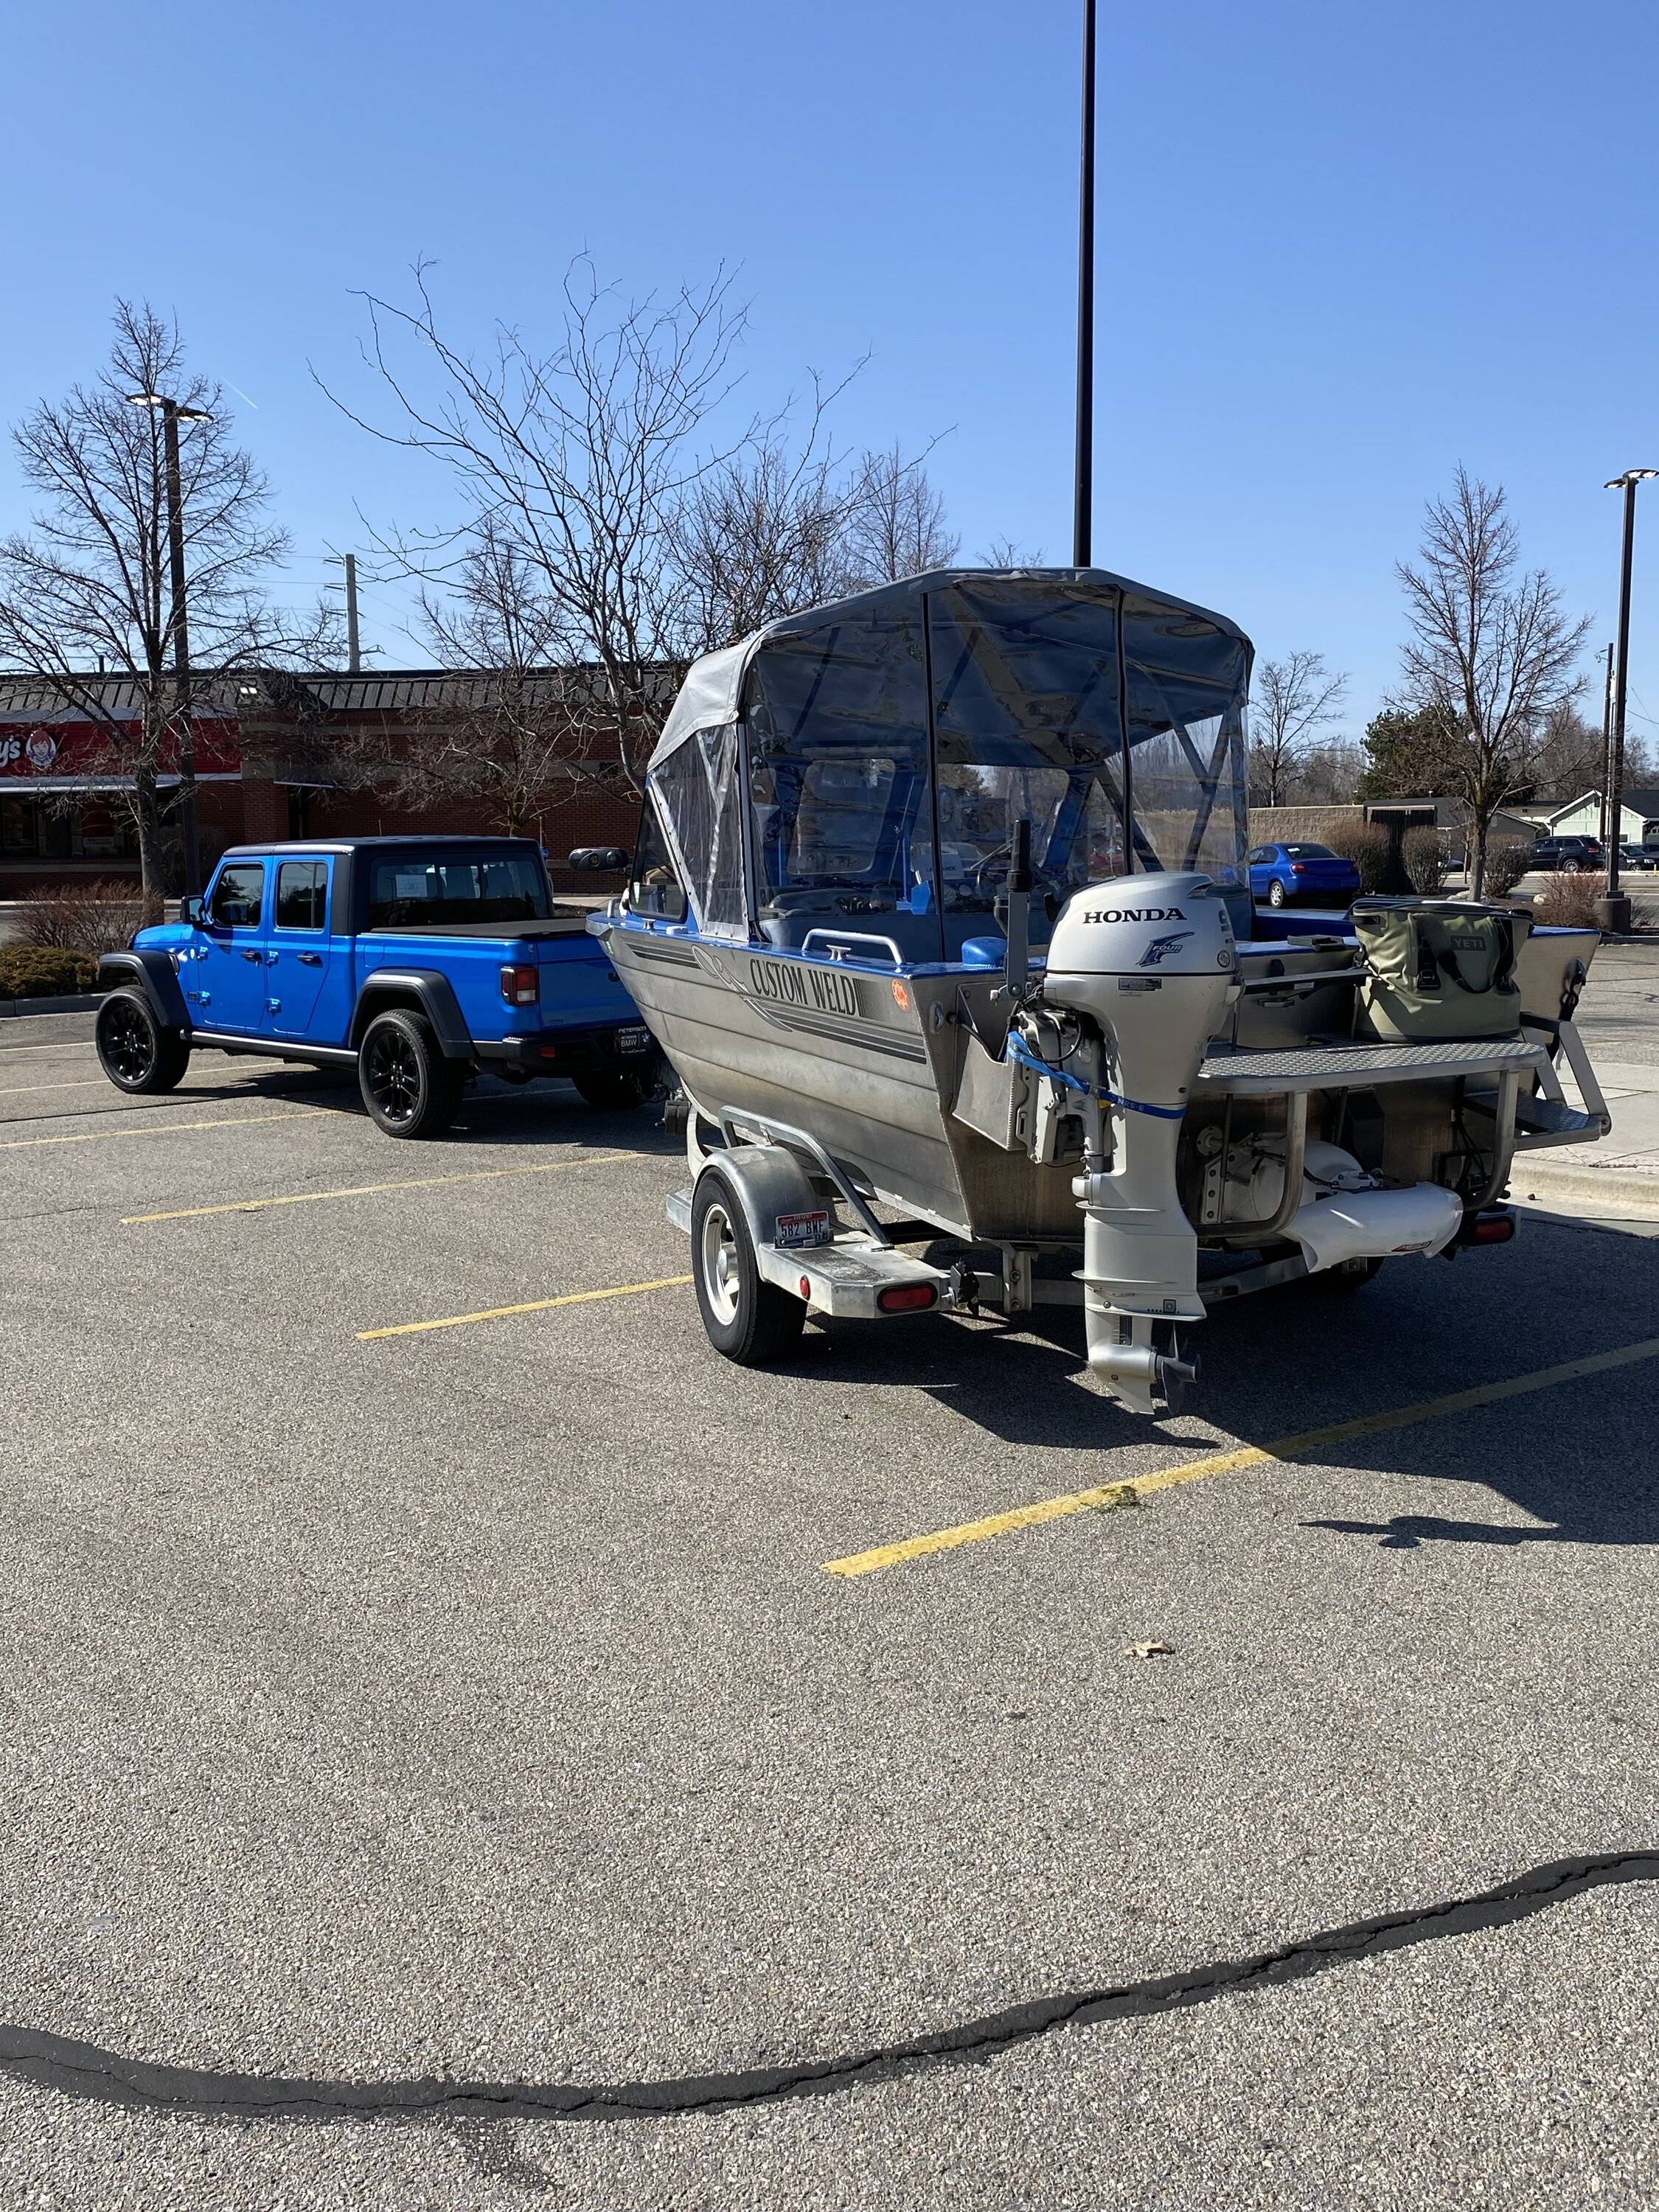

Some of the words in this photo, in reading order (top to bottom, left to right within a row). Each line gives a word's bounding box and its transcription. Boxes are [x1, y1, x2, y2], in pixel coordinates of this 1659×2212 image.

[1082, 908, 1188, 924] HONDA
[1453, 939, 1483, 948] YETI
[750, 959, 809, 1005] CUSTOM
[807, 969, 857, 1016] WELD
[621, 1039, 638, 1047] BMW
[781, 1222, 800, 1237] 582
